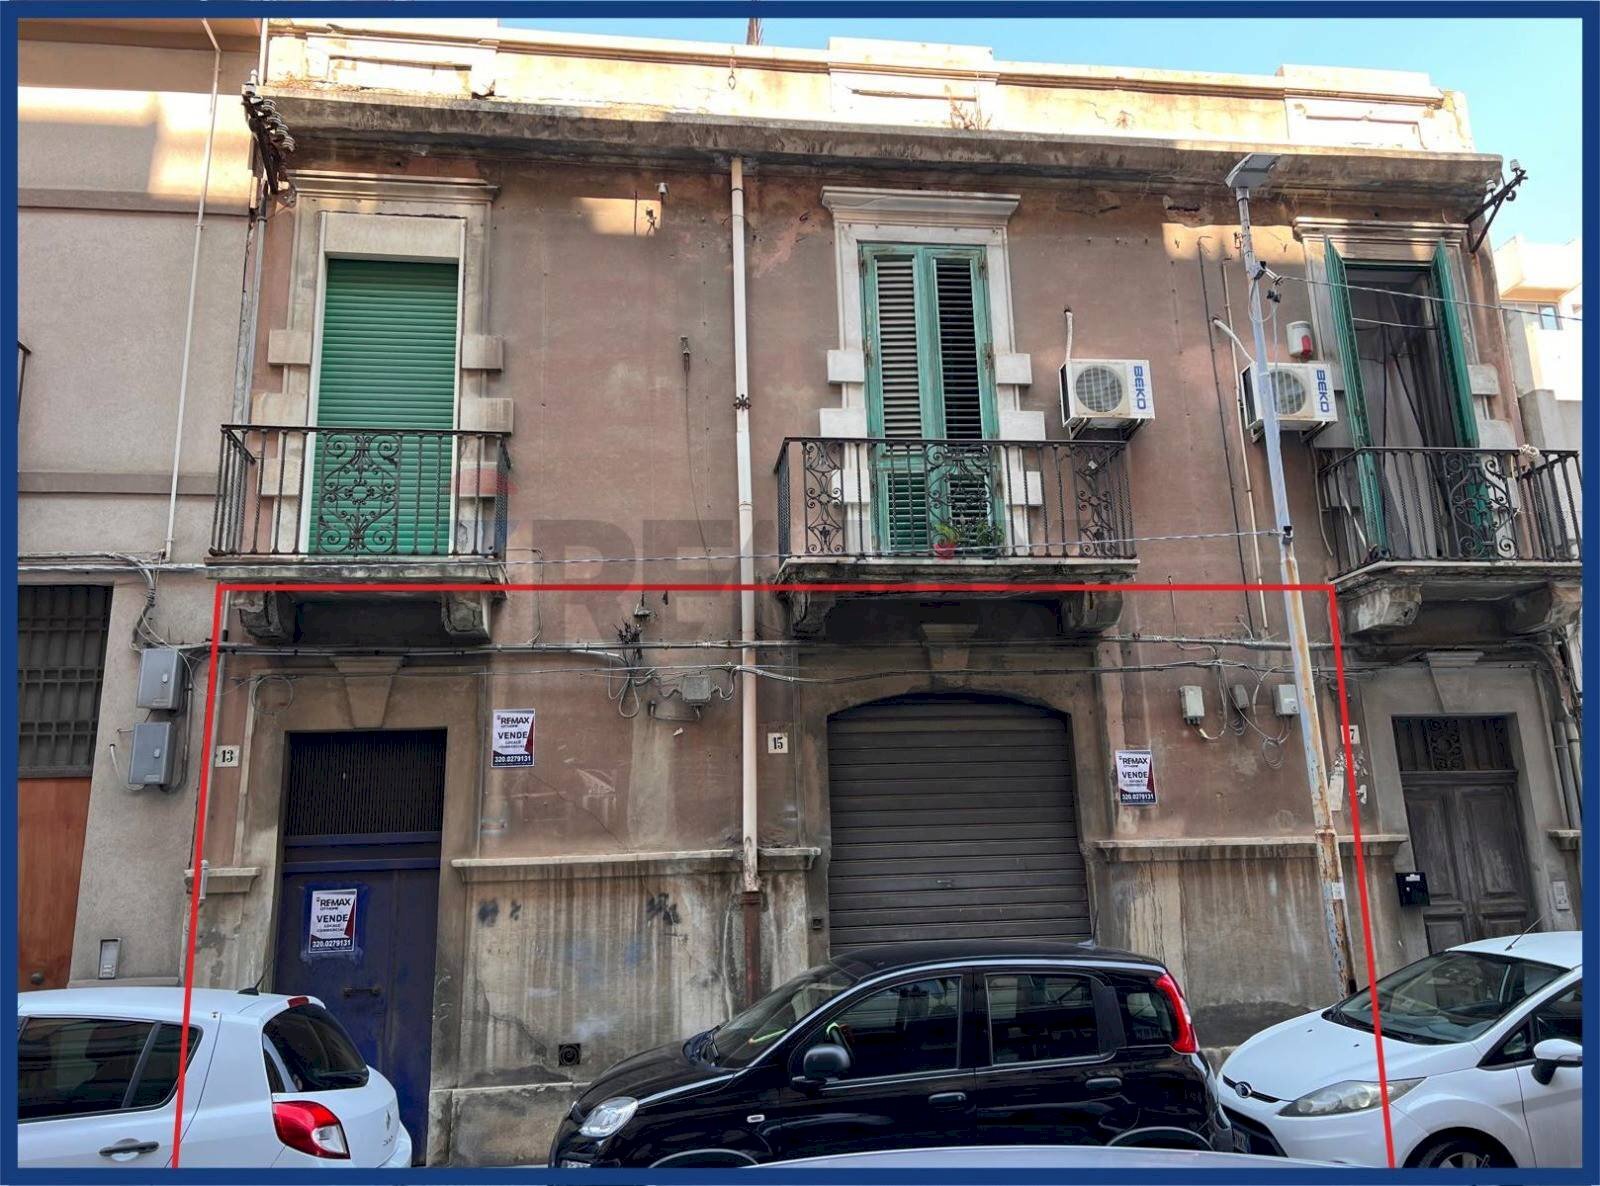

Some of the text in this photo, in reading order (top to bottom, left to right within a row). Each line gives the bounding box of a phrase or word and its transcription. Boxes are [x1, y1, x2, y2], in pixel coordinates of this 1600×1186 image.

[1134, 366, 1146, 410] BEKO
[1317, 370, 1330, 413] BEKO
[500, 716, 530, 725] REMAX
[497, 731, 528, 740] VENDE
[773, 736, 784, 750] 15
[222, 750, 234, 763] 13
[1122, 757, 1148, 765] REMAX
[1121, 771, 1149, 779] VENDE
[320, 898, 351, 907] REMAX
[316, 914, 348, 923] VENDE
